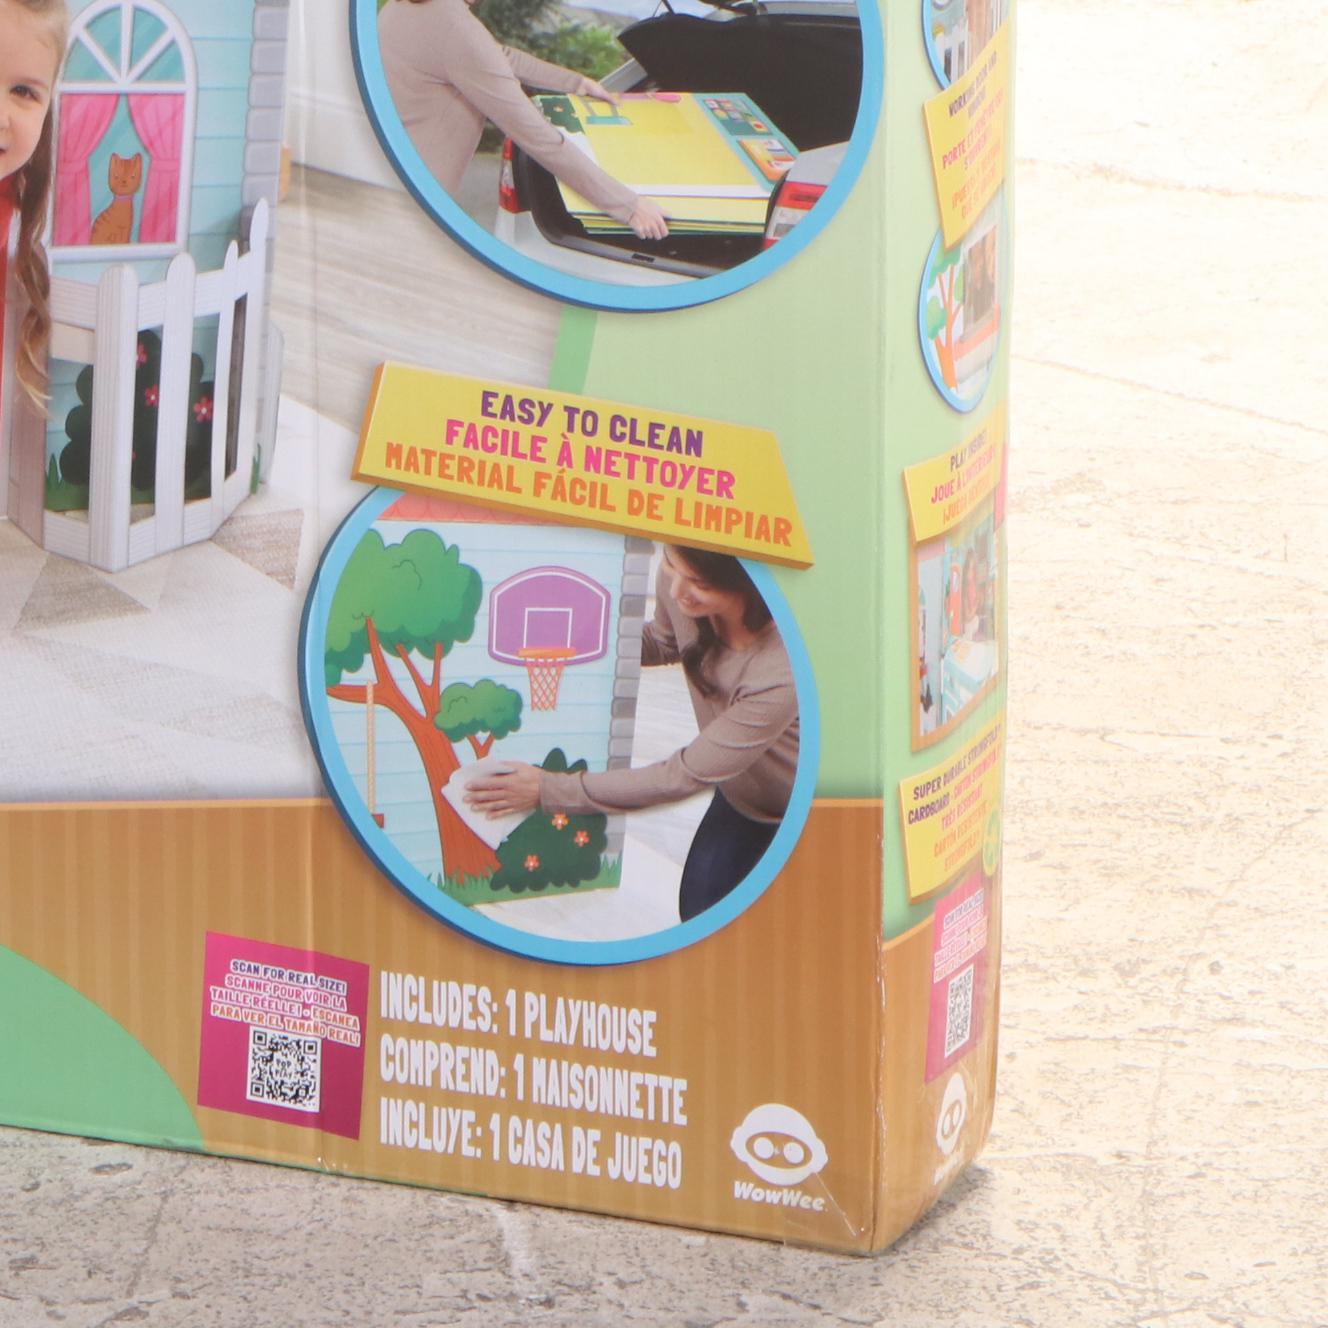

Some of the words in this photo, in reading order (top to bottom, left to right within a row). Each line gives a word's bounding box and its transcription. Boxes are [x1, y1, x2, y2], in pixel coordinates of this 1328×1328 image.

[445, 419, 547, 463] FACILE
[557, 433, 573, 469] À
[584, 445, 735, 499] NETTOYER
[481, 391, 552, 428] EASY
[563, 406, 599, 438] TO
[610, 415, 703, 458] CLEAN
[385, 442, 523, 494] MATERIAL
[533, 468, 616, 512] FÁCIL
[627, 489, 663, 522] DE
[674, 499, 792, 547] LIMPIAR
[380, 970, 499, 1034] INCLUDES:
[505, 988, 518, 1036] 1
[524, 992, 657, 1058] PLAYHOUSE
[380, 1034, 507, 1099] COMPREND:
[512, 1051, 525, 1102] 1
[531, 1056, 687, 1126] MAISONNETTE
[380, 1097, 483, 1159] INCLUYE:
[489, 1112, 500, 1163] 1
[508, 1117, 565, 1171] CASA
[571, 1127, 601, 1177] DE
[607, 1131, 682, 1189] JUEGO
[733, 1180, 827, 1212] WowWee
